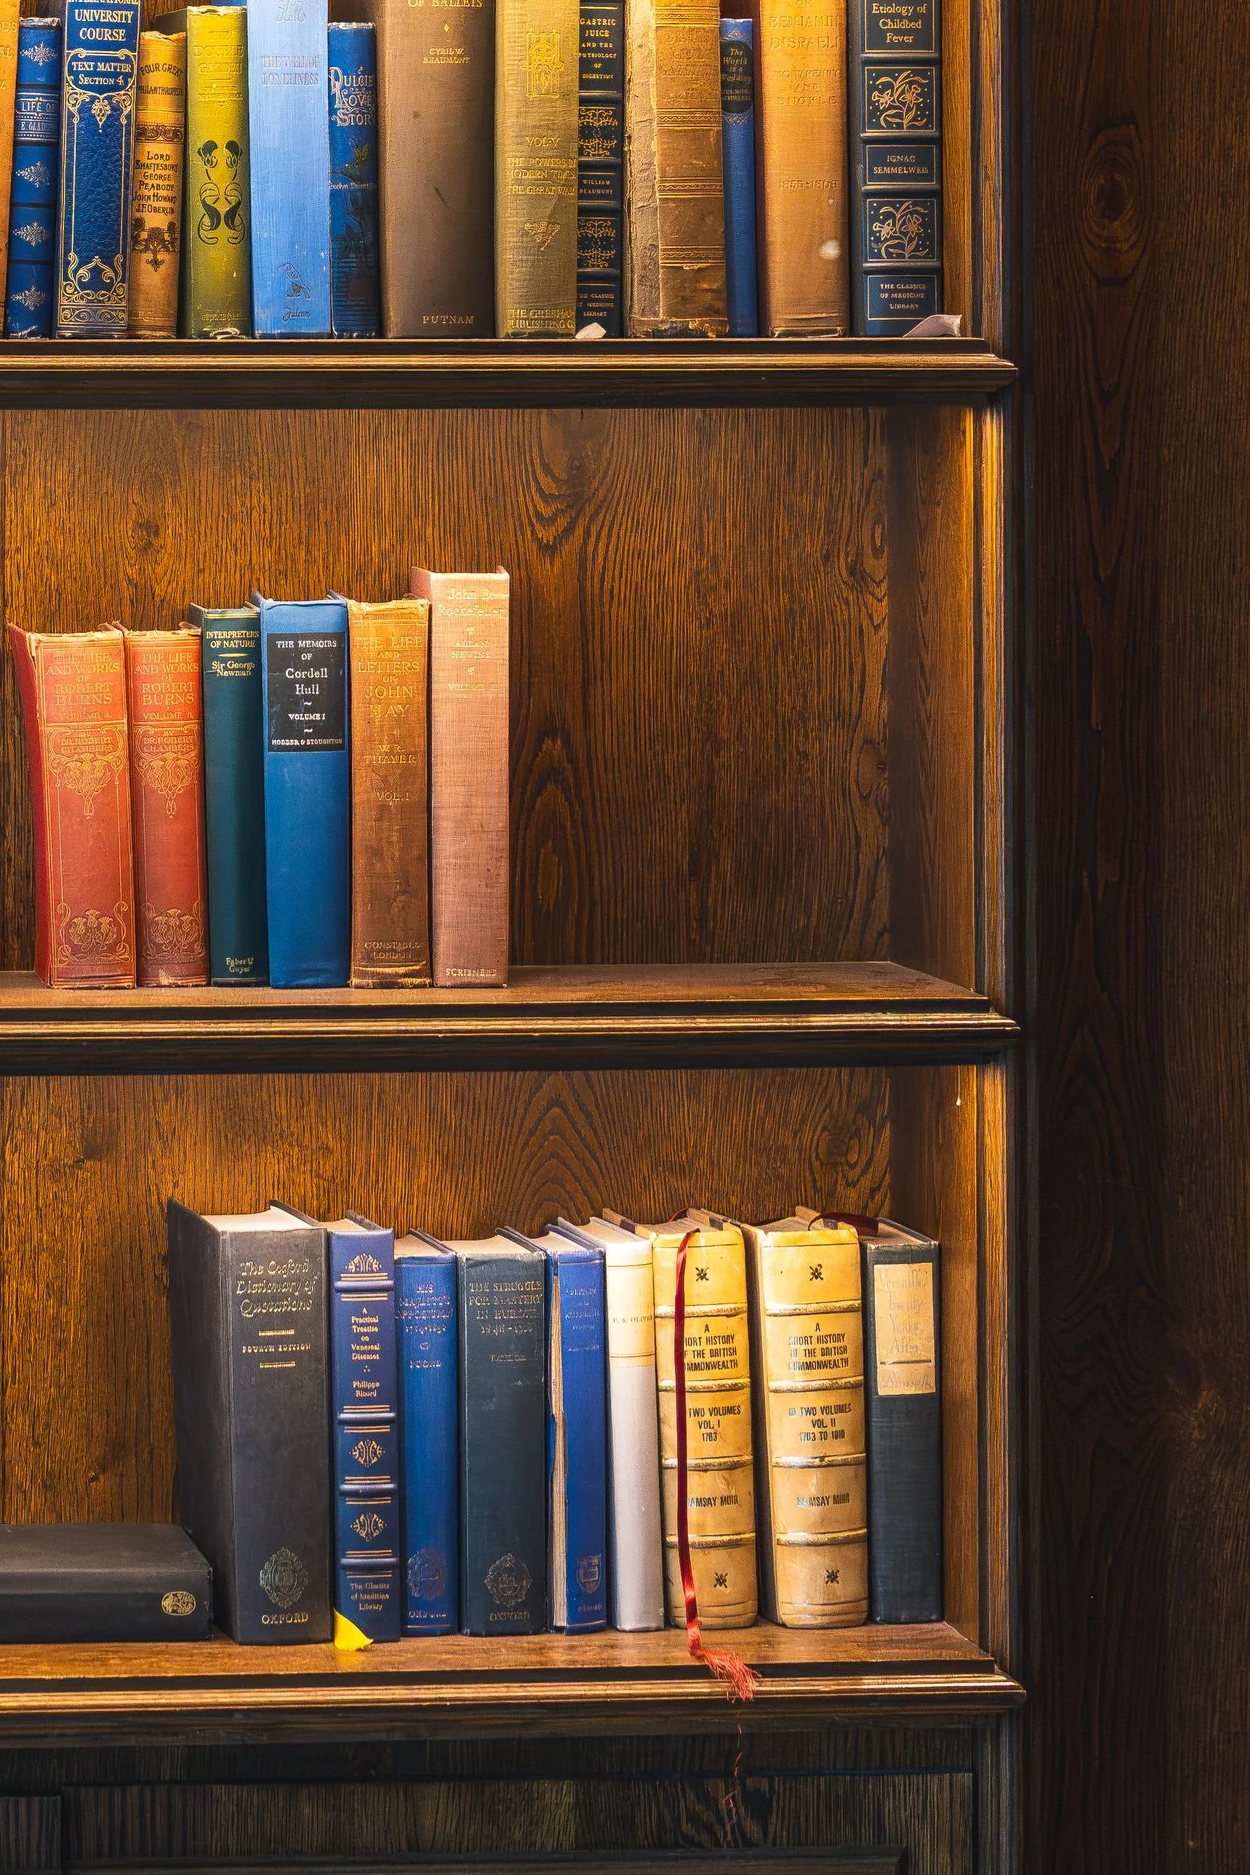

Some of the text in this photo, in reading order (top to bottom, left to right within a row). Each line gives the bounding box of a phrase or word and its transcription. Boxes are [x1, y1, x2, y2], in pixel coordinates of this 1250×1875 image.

[872, 3, 927, 16] Etiology of
[74, 9, 133, 23] UNIVERSITY
[580, 18, 616, 26] GASTRIC
[879, 18, 922, 31] Childbed
[79, 27, 126, 41] COURSE
[886, 32, 914, 44] Fever
[72, 61, 132, 73] TEXT MATTER
[141, 63, 183, 77] FOUR GREAT
[147, 151, 170, 161] LORD
[143, 172, 171, 181] GEORGE
[423, 315, 474, 325] PUTNAM
[206, 630, 260, 639] INTERPRETERS
[276, 640, 337, 649] THE MEMOIRS
[354, 637, 423, 648] THE LIFE
[301, 653, 313, 661] OF
[212, 661, 225, 670] Sir
[358, 661, 420, 673] LETTERS
[285, 667, 328, 680] Cordell
[295, 684, 320, 696] Hull
[365, 686, 413, 698] JOHN
[706, 1334, 735, 1345] HISTORY
[692, 1348, 737, 1358] THE BRITISH
[689, 1405, 741, 1417] TWO VOLUMES
[800, 1403, 851, 1416] TWO VOLUMES
[261, 1613, 309, 1625] OXFORD
